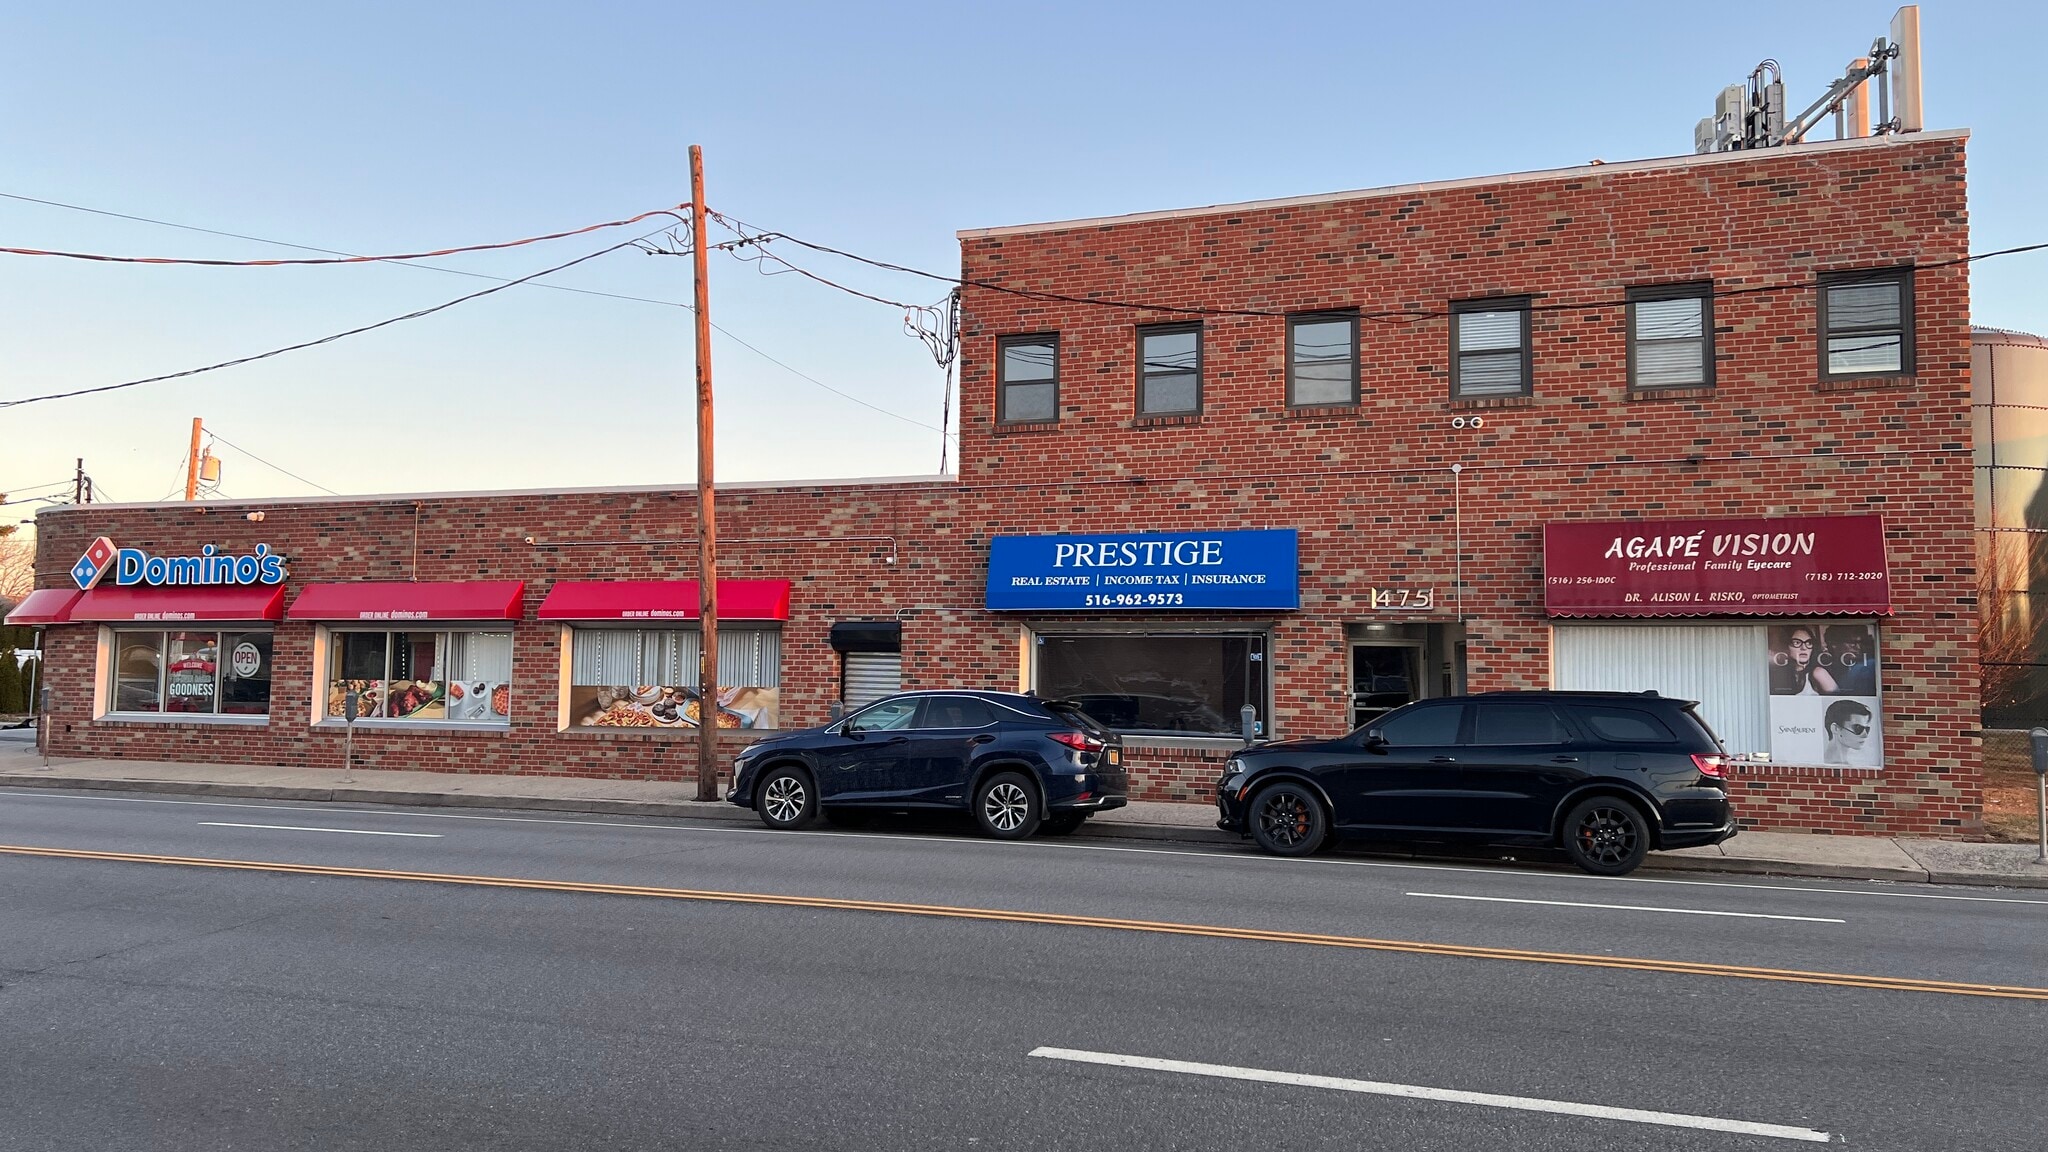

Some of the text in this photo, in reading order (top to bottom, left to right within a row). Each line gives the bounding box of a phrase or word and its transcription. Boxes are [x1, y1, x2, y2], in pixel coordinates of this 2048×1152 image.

[1605, 530, 1815, 558] AGAPÉ VISION
[1053, 541, 1223, 567] PRESTIGE
[116, 543, 286, 585] Domino's
[1629, 560, 1792, 573] Professional Family Eyecare
[1011, 574, 1266, 586] REAL ESTATE INCOME TAX INSURANCE
[1548, 576, 1573, 584] (516)
[1805, 572, 1883, 581] (718) 712-2020
[1085, 593, 1183, 606] 516-962-9573
[1376, 589, 1429, 607] 475
[1624, 593, 1643, 602] DR.
[1650, 593, 1691, 602] ALISON
[1694, 592, 1704, 601] L.
[1709, 592, 1745, 603] RISKO,
[391, 610, 428, 619] dominos.com
[650, 609, 684, 617] dominos.com
[234, 651, 257, 664] OPEN
[169, 683, 214, 696] GOODNESS
